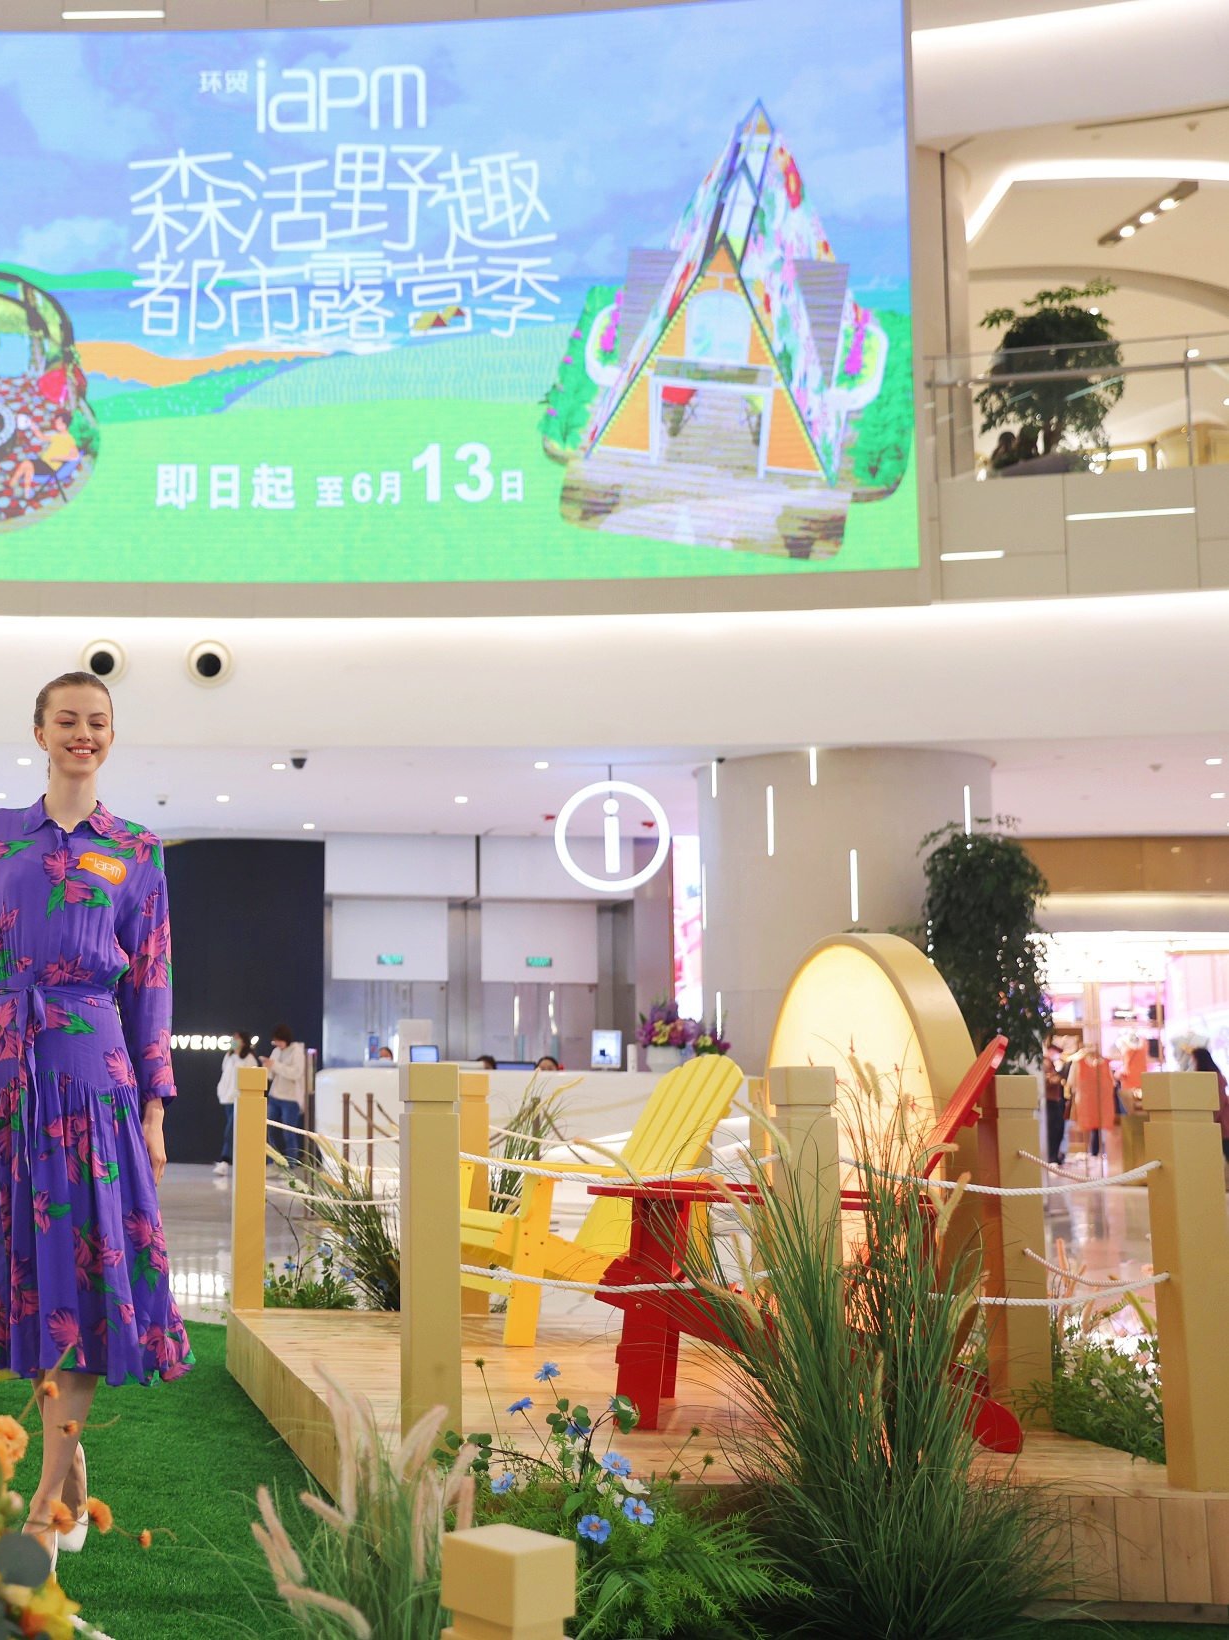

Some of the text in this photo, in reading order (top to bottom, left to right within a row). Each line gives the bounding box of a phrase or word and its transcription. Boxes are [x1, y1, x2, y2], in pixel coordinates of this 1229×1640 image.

[198, 58, 426, 133] 环贸 iapm
[129, 143, 557, 258] 森活野趣
[129, 252, 561, 344] 都市露营季
[155, 442, 525, 510] 即日起 至6月13日
